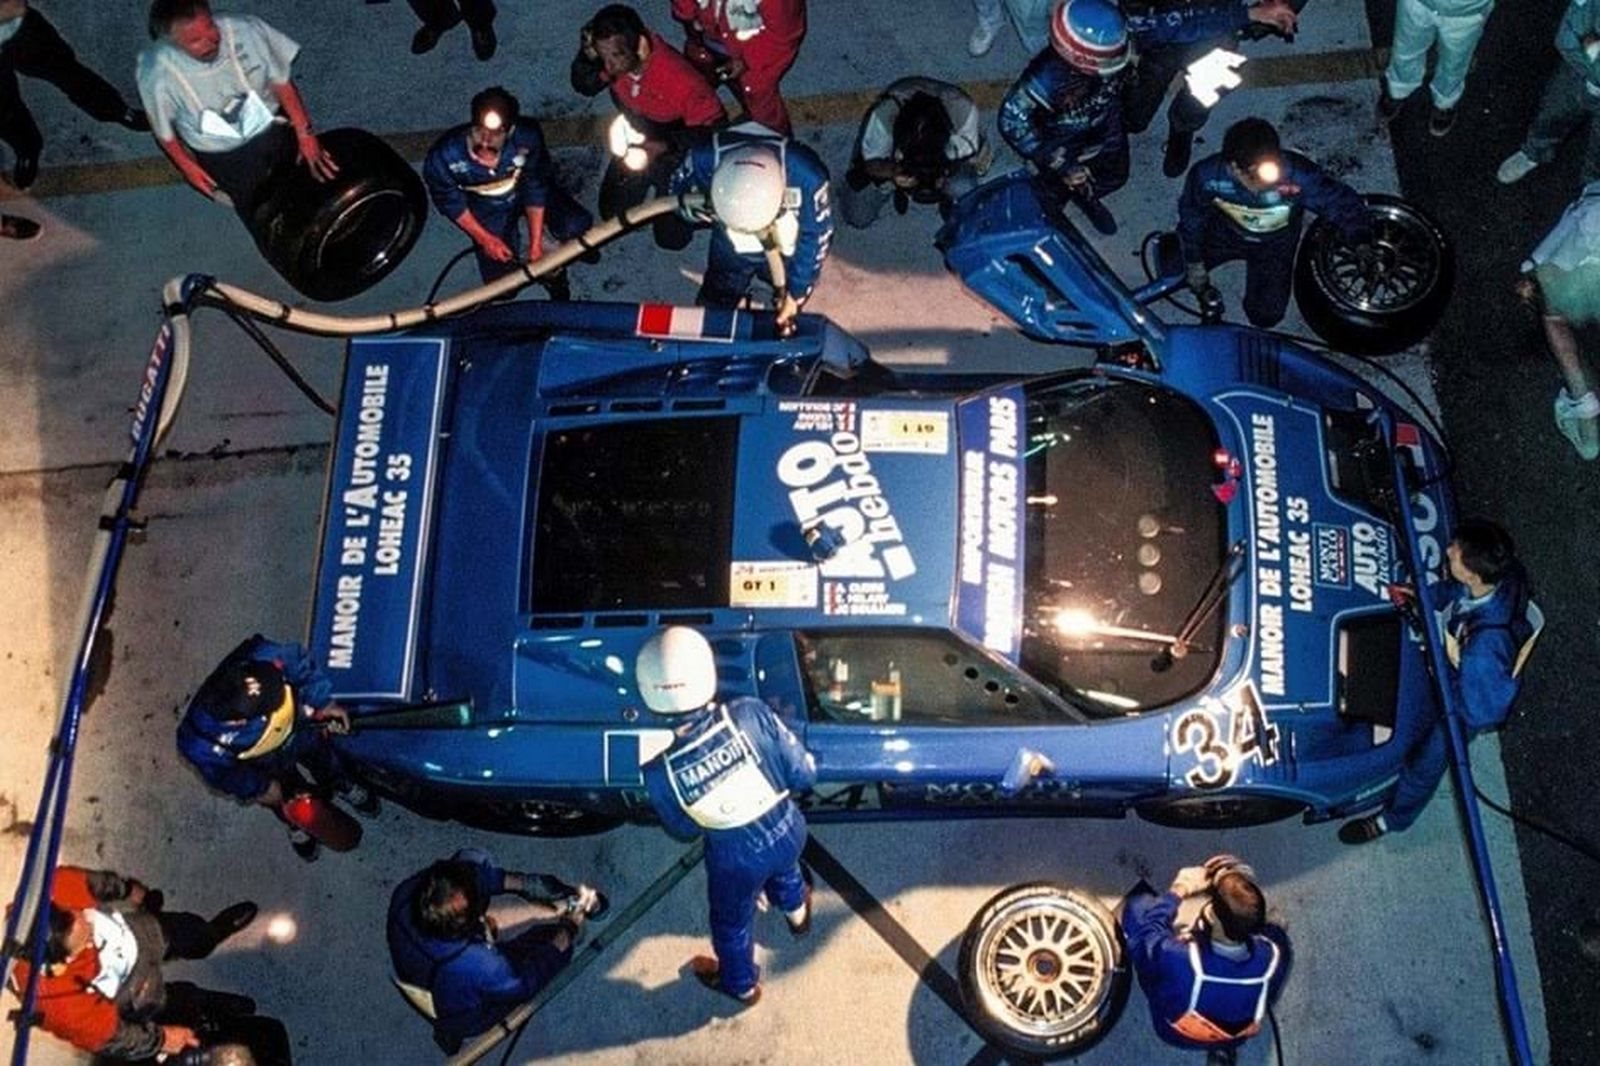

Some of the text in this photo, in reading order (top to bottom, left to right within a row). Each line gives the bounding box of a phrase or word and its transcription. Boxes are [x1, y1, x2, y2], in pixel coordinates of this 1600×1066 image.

[131, 324, 171, 441] BUGATTI
[989, 396, 1018, 458] PARIS
[327, 364, 390, 669] MANOIR DE L'AUTOMOBILE
[373, 453, 412, 576] LOHEAC 35
[776, 440, 886, 578] AUTO
[830, 431, 904, 543] hebdo
[988, 461, 1018, 561] MOTORS
[743, 580, 776, 591] GT 1
[1251, 412, 1286, 696] MANOIR DE L'AUTOMOBILE
[1285, 496, 1314, 612] LOHEAC 35
[1318, 527, 1331, 582] MONTE
[1327, 528, 1340, 583] CARLO
[1352, 521, 1379, 595] AUTO
[1373, 526, 1391, 584] hebdo
[1173, 677, 1280, 791] 34
